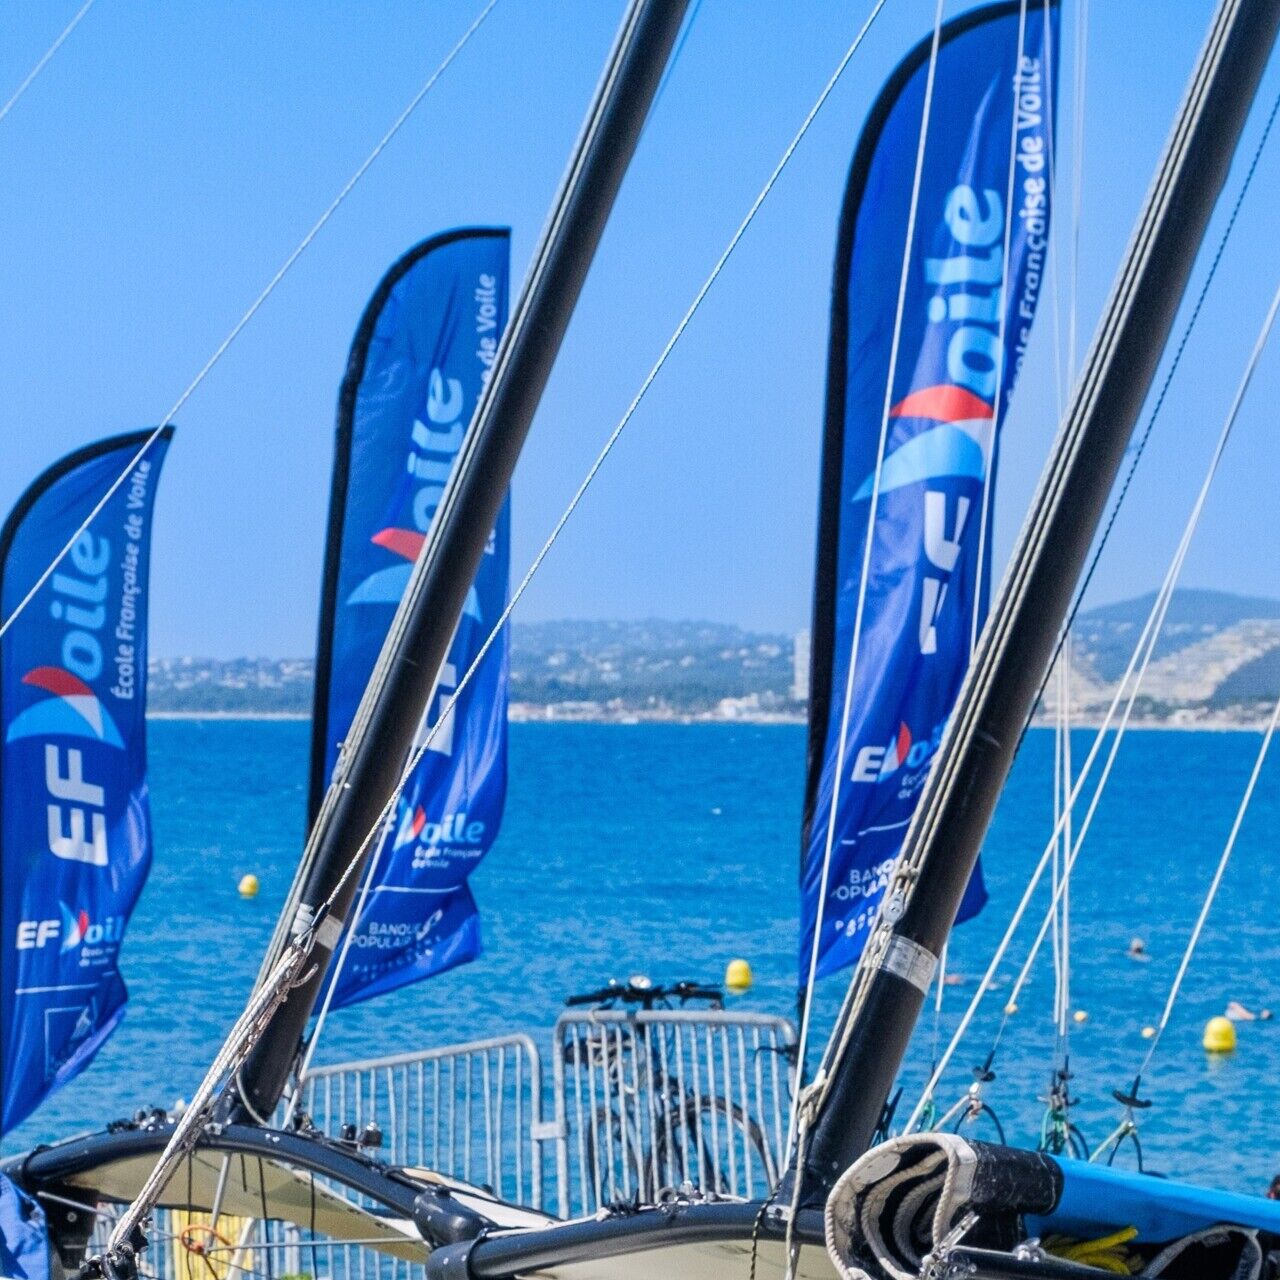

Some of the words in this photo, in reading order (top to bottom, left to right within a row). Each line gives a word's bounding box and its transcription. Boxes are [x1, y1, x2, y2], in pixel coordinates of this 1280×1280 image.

[1013, 55, 1042, 131] Voile
[1016, 136, 1045, 172] de
[1019, 176, 1048, 321] Française
[475, 273, 497, 332] Voile
[126, 460, 152, 509] Voile
[123, 513, 143, 540] de
[115, 542, 142, 641] Française
[110, 643, 134, 700] École
[45, 743, 109, 867] EF
[16, 919, 61, 951] EF
